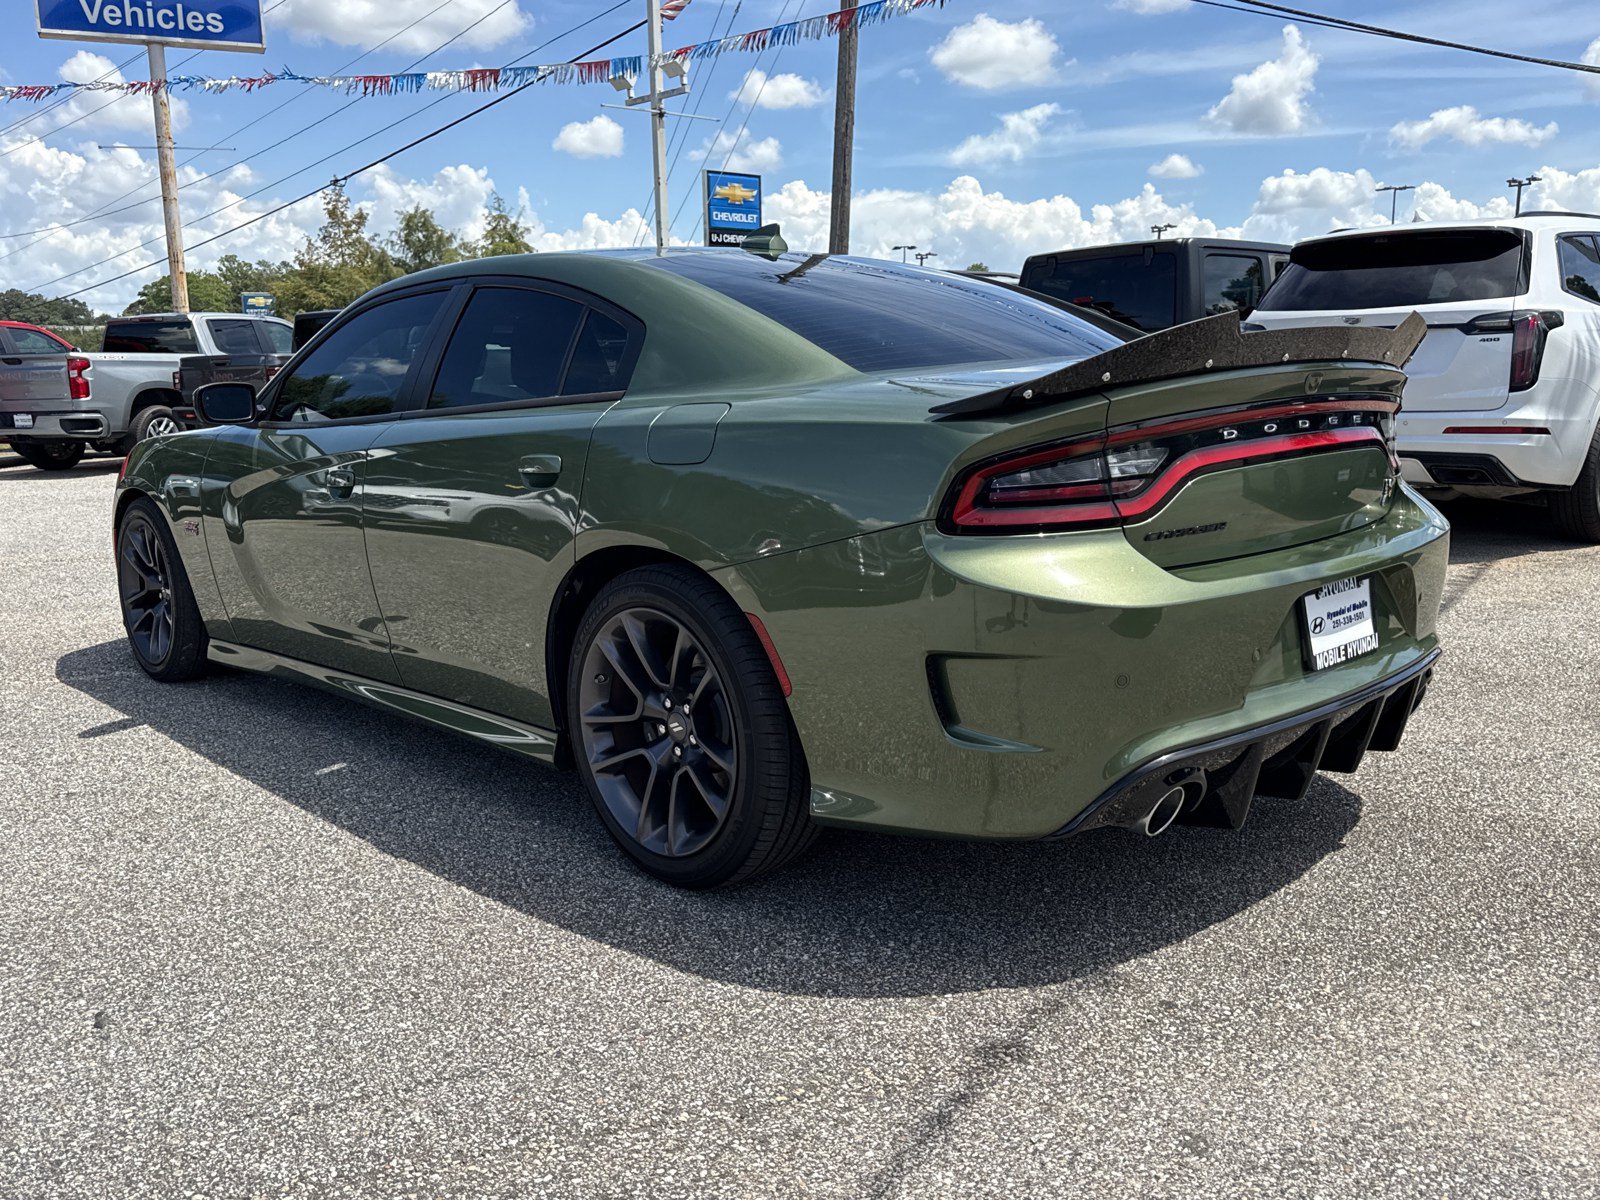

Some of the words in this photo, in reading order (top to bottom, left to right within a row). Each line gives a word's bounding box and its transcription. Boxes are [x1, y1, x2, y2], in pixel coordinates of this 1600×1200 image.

[79, 0, 225, 33] Vehicles
[712, 211, 758, 223] CHEVROLET
[711, 233, 722, 242] U-J
[1223, 415, 1362, 440] DODGE
[1322, 577, 1358, 598] HYUNDAI
[1327, 605, 1346, 620] Hyundai
[1347, 604, 1352, 613] of
[1352, 599, 1368, 611] Mobile
[1332, 611, 1365, 629] 251-338-1501
[1316, 645, 1346, 671] MOBILE
[1346, 632, 1379, 659] HYUNDAI
